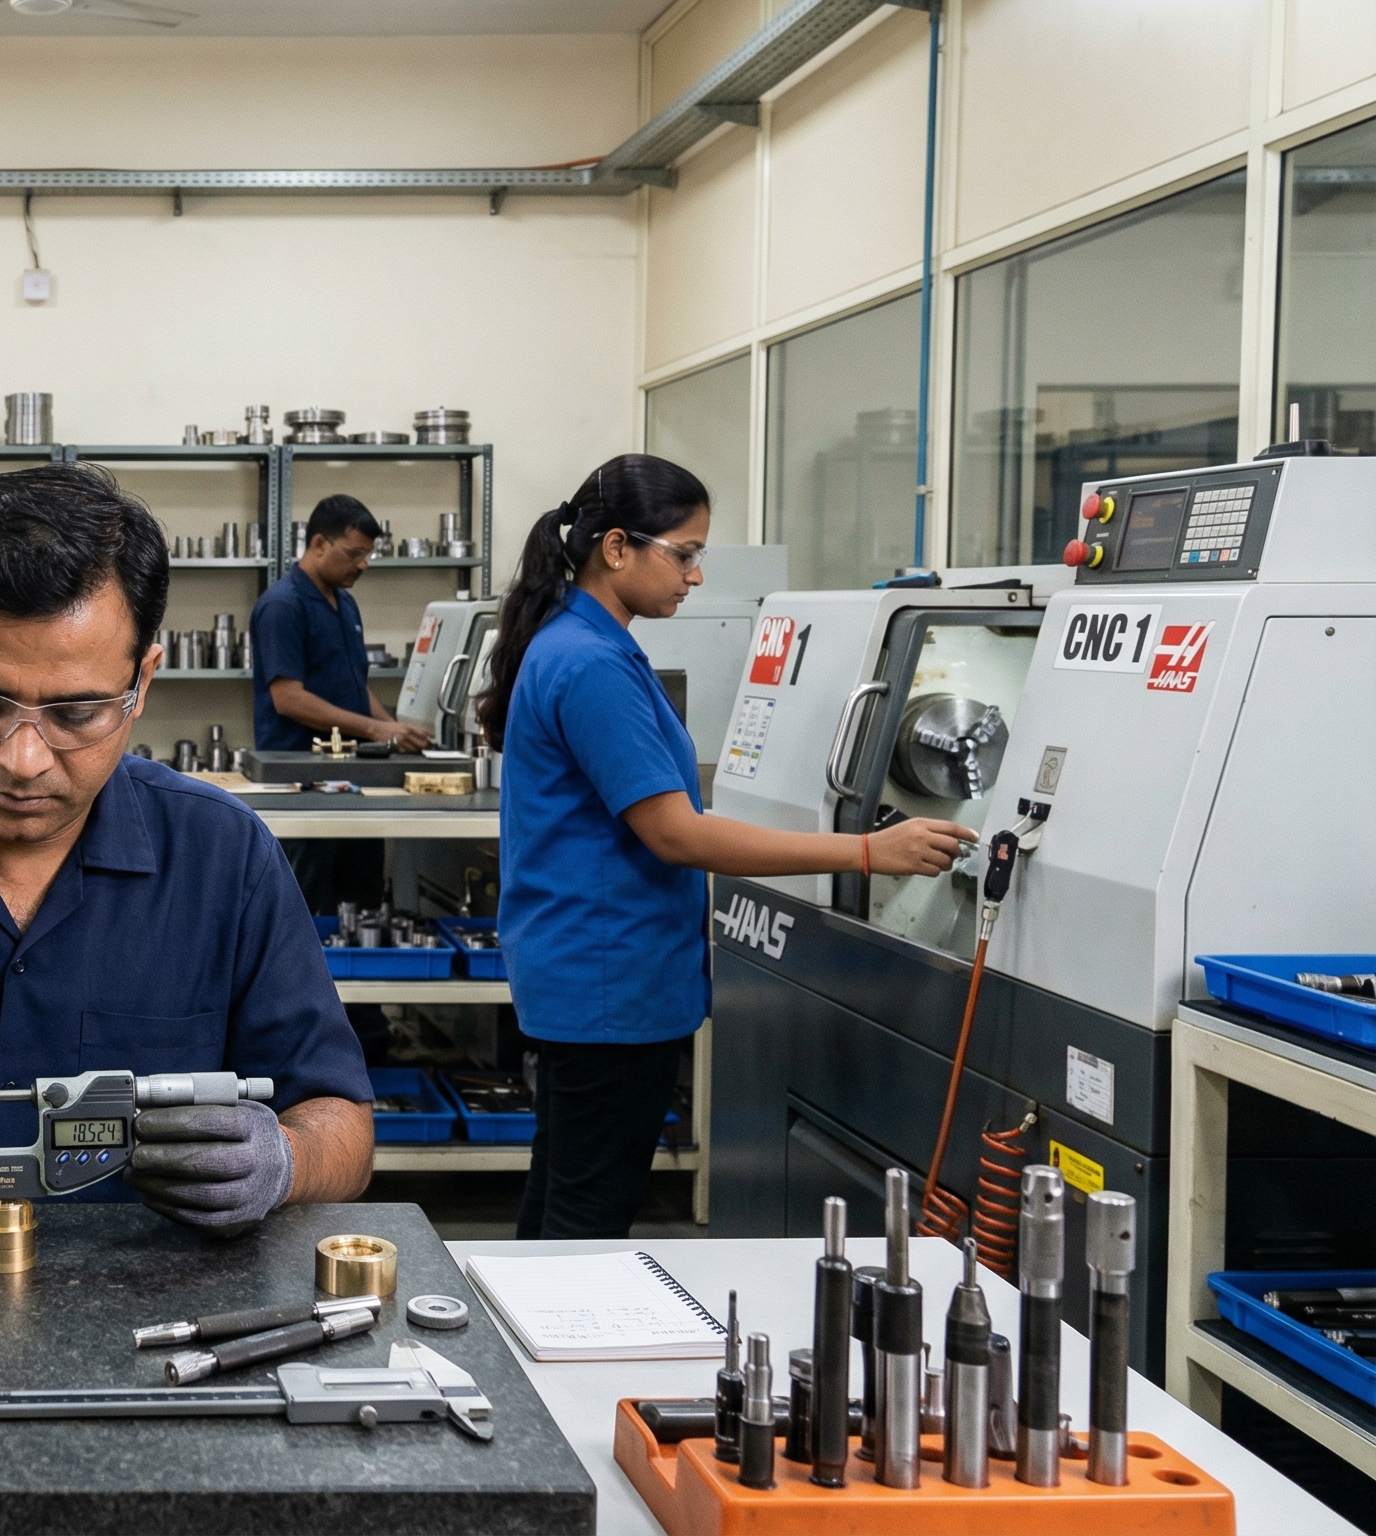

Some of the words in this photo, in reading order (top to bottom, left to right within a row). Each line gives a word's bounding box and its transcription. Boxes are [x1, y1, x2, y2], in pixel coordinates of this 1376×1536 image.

[756, 616, 792, 658] CNC
[789, 623, 812, 686] 1
[1062, 613, 1128, 662] CNC
[1131, 613, 1153, 663] 1
[1147, 669, 1199, 690] HAAS
[713, 893, 795, 960] HAAS
